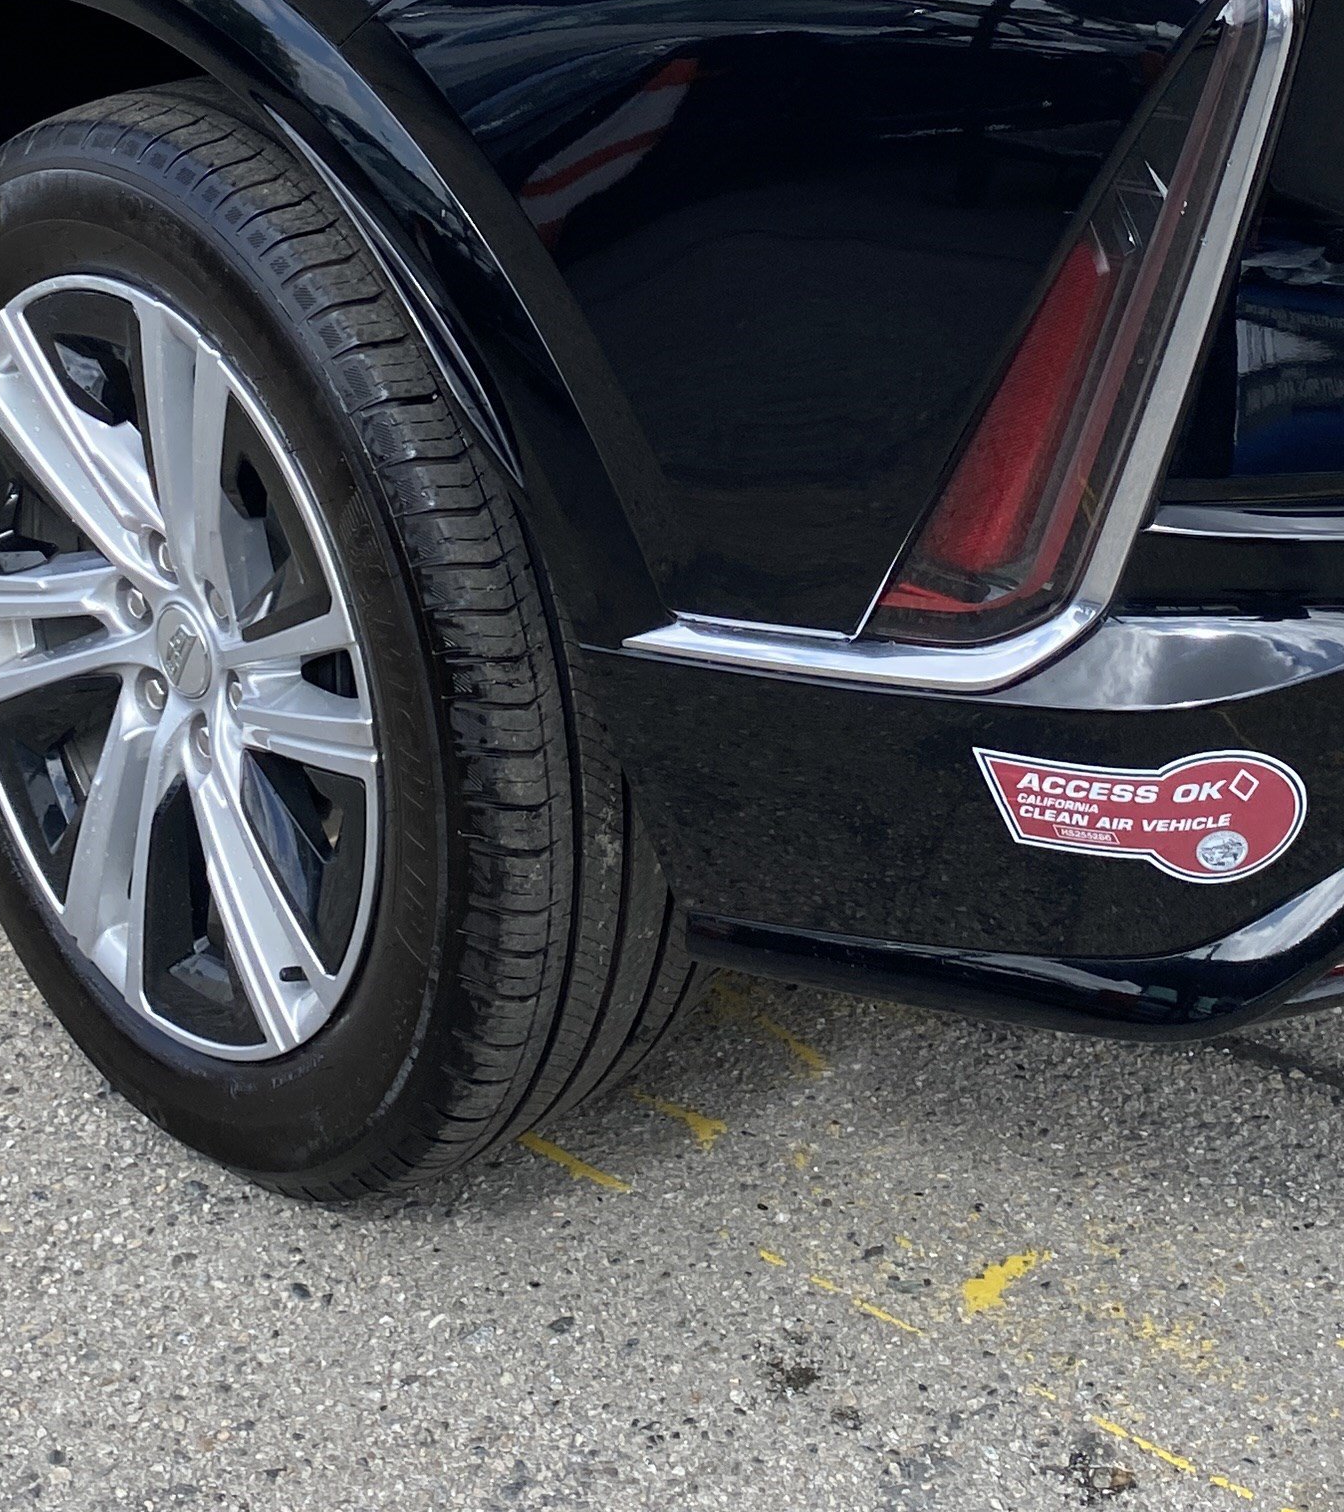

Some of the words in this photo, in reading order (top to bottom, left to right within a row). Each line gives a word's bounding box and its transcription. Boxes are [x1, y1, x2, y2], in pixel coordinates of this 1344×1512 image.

[1016, 772, 1159, 804] ACCESS
[1172, 778, 1229, 804] OK
[1016, 792, 1100, 815] CALIFORNIA
[1019, 805, 1090, 828] CLEAN
[1095, 816, 1135, 832] AIR
[1142, 813, 1233, 833] VEHICLE
